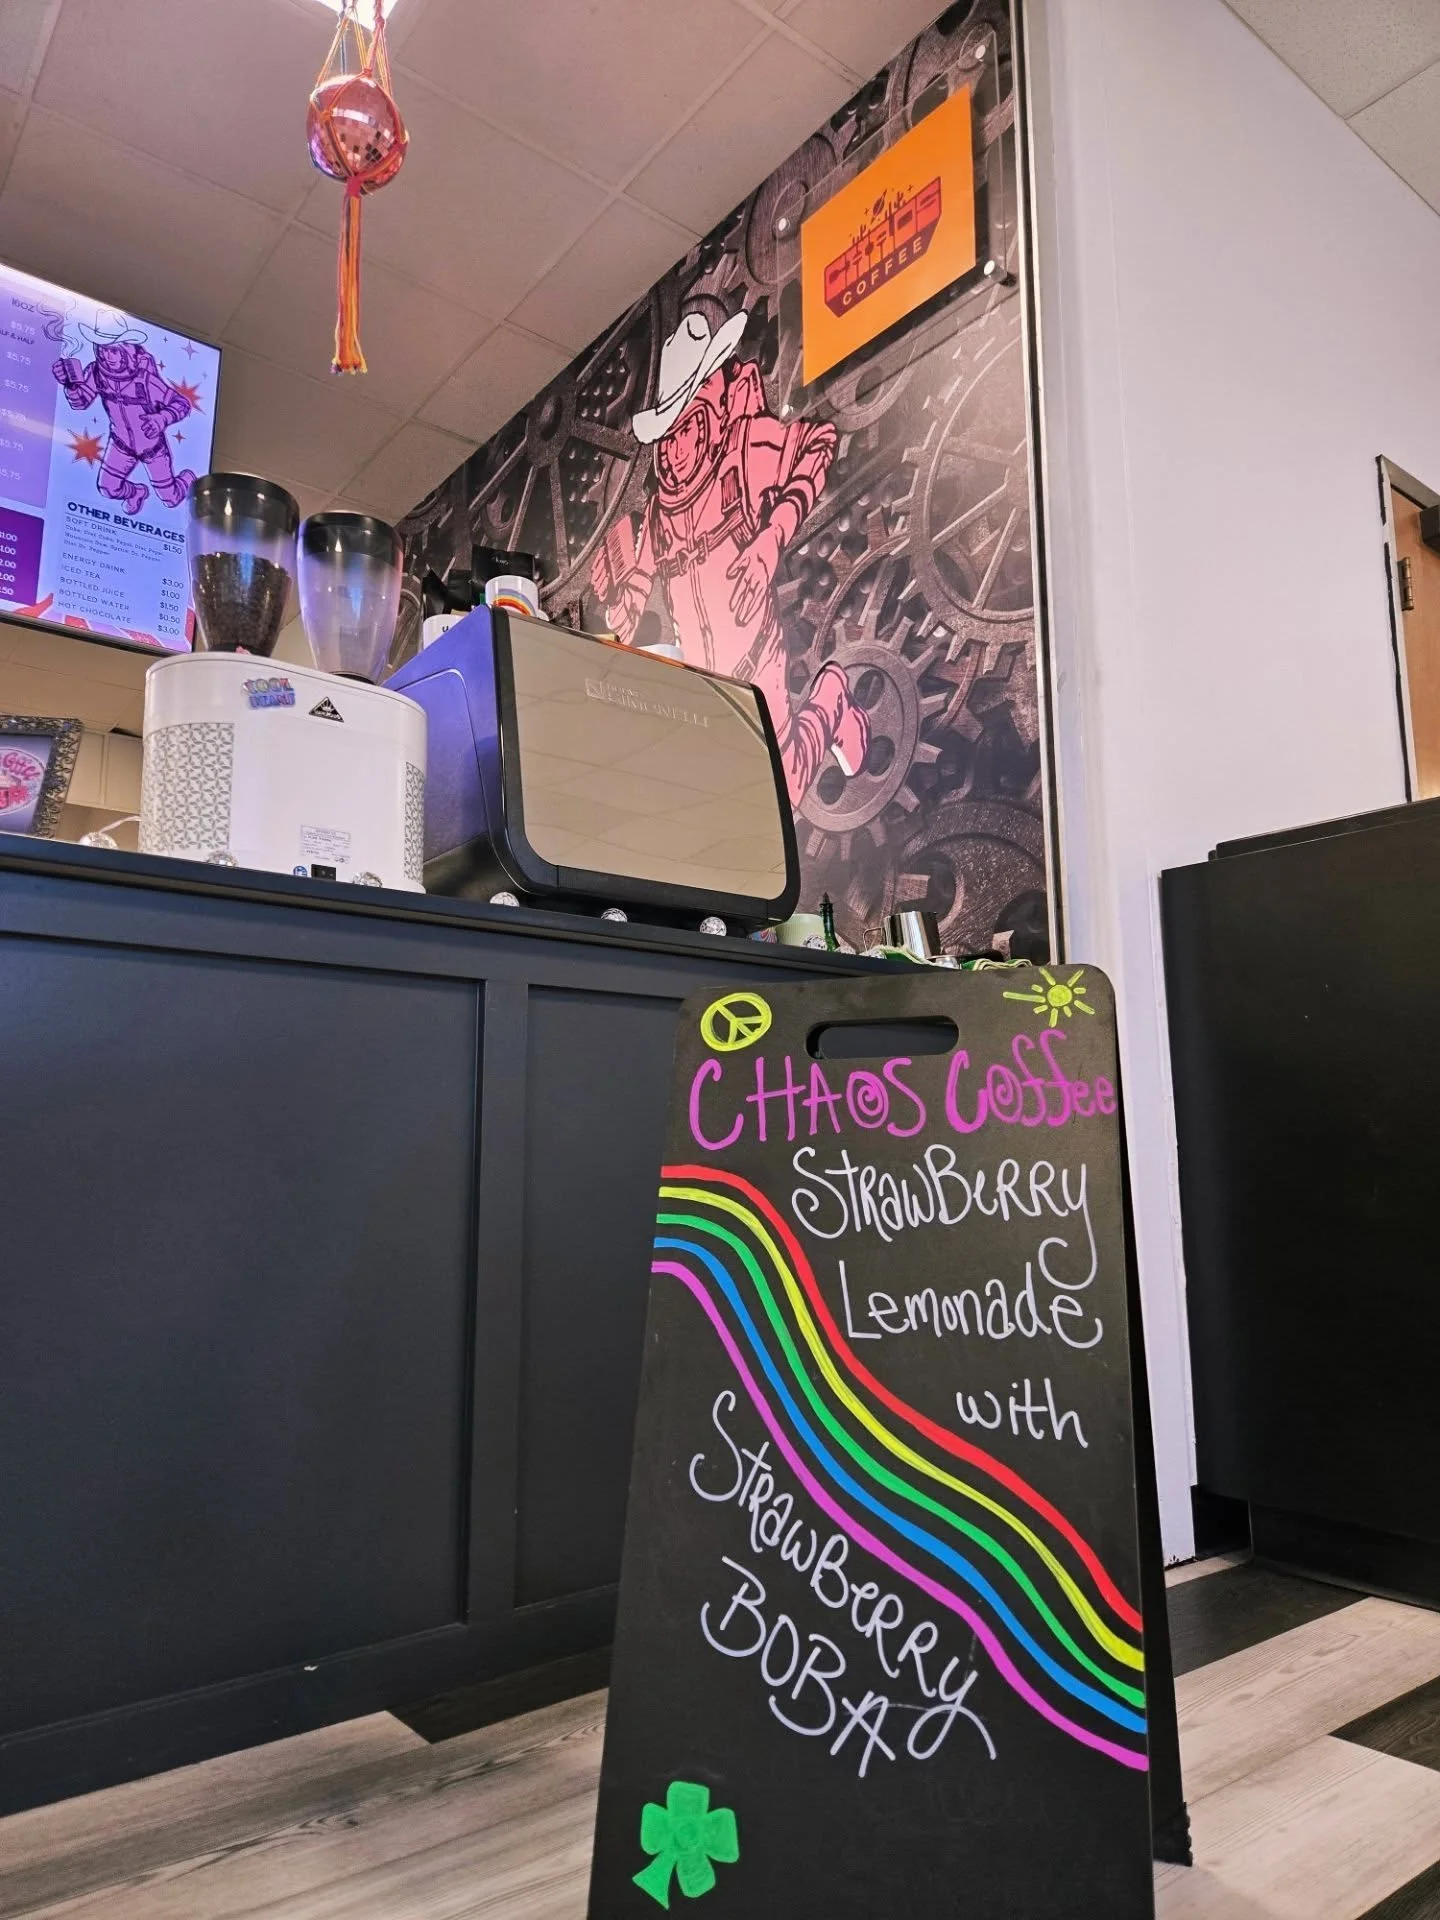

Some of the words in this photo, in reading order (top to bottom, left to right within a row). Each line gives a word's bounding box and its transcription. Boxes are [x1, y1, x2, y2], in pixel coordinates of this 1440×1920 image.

[843, 236, 922, 306] COFFEE
[7, 351, 31, 366] $5.75
[4, 379, 29, 393] $5.75
[65, 516, 89, 527] SOFT
[91, 523, 117, 536] DRINK
[67, 502, 110, 521] OTHER
[114, 515, 185, 543] BEVERAGES
[163, 543, 183, 555] $1.50
[61, 564, 81, 575] ICED
[84, 570, 101, 580] TEA
[62, 552, 96, 567] ENERGY
[99, 562, 126, 575] DRINK
[60, 576, 99, 592] BOTTLED
[101, 587, 125, 598] JUICE
[162, 578, 184, 589] $3.00
[59, 588, 98, 603] BOTTLED
[101, 598, 130, 611] WATER
[161, 589, 180, 600] $1.00
[58, 601, 76, 610] HOT
[79, 606, 132, 624] CHOCOLATE
[160, 601, 179, 612] $1.50
[159, 613, 181, 624] $0.50
[158, 624, 180, 636] $3.00
[689, 1055, 926, 1151] CHAOS
[945, 1029, 1117, 1134] Coffee
[838, 1260, 1104, 1349] Lemonade
[955, 1377, 1089, 1449] with
[700, 1555, 897, 1778] BOBA
